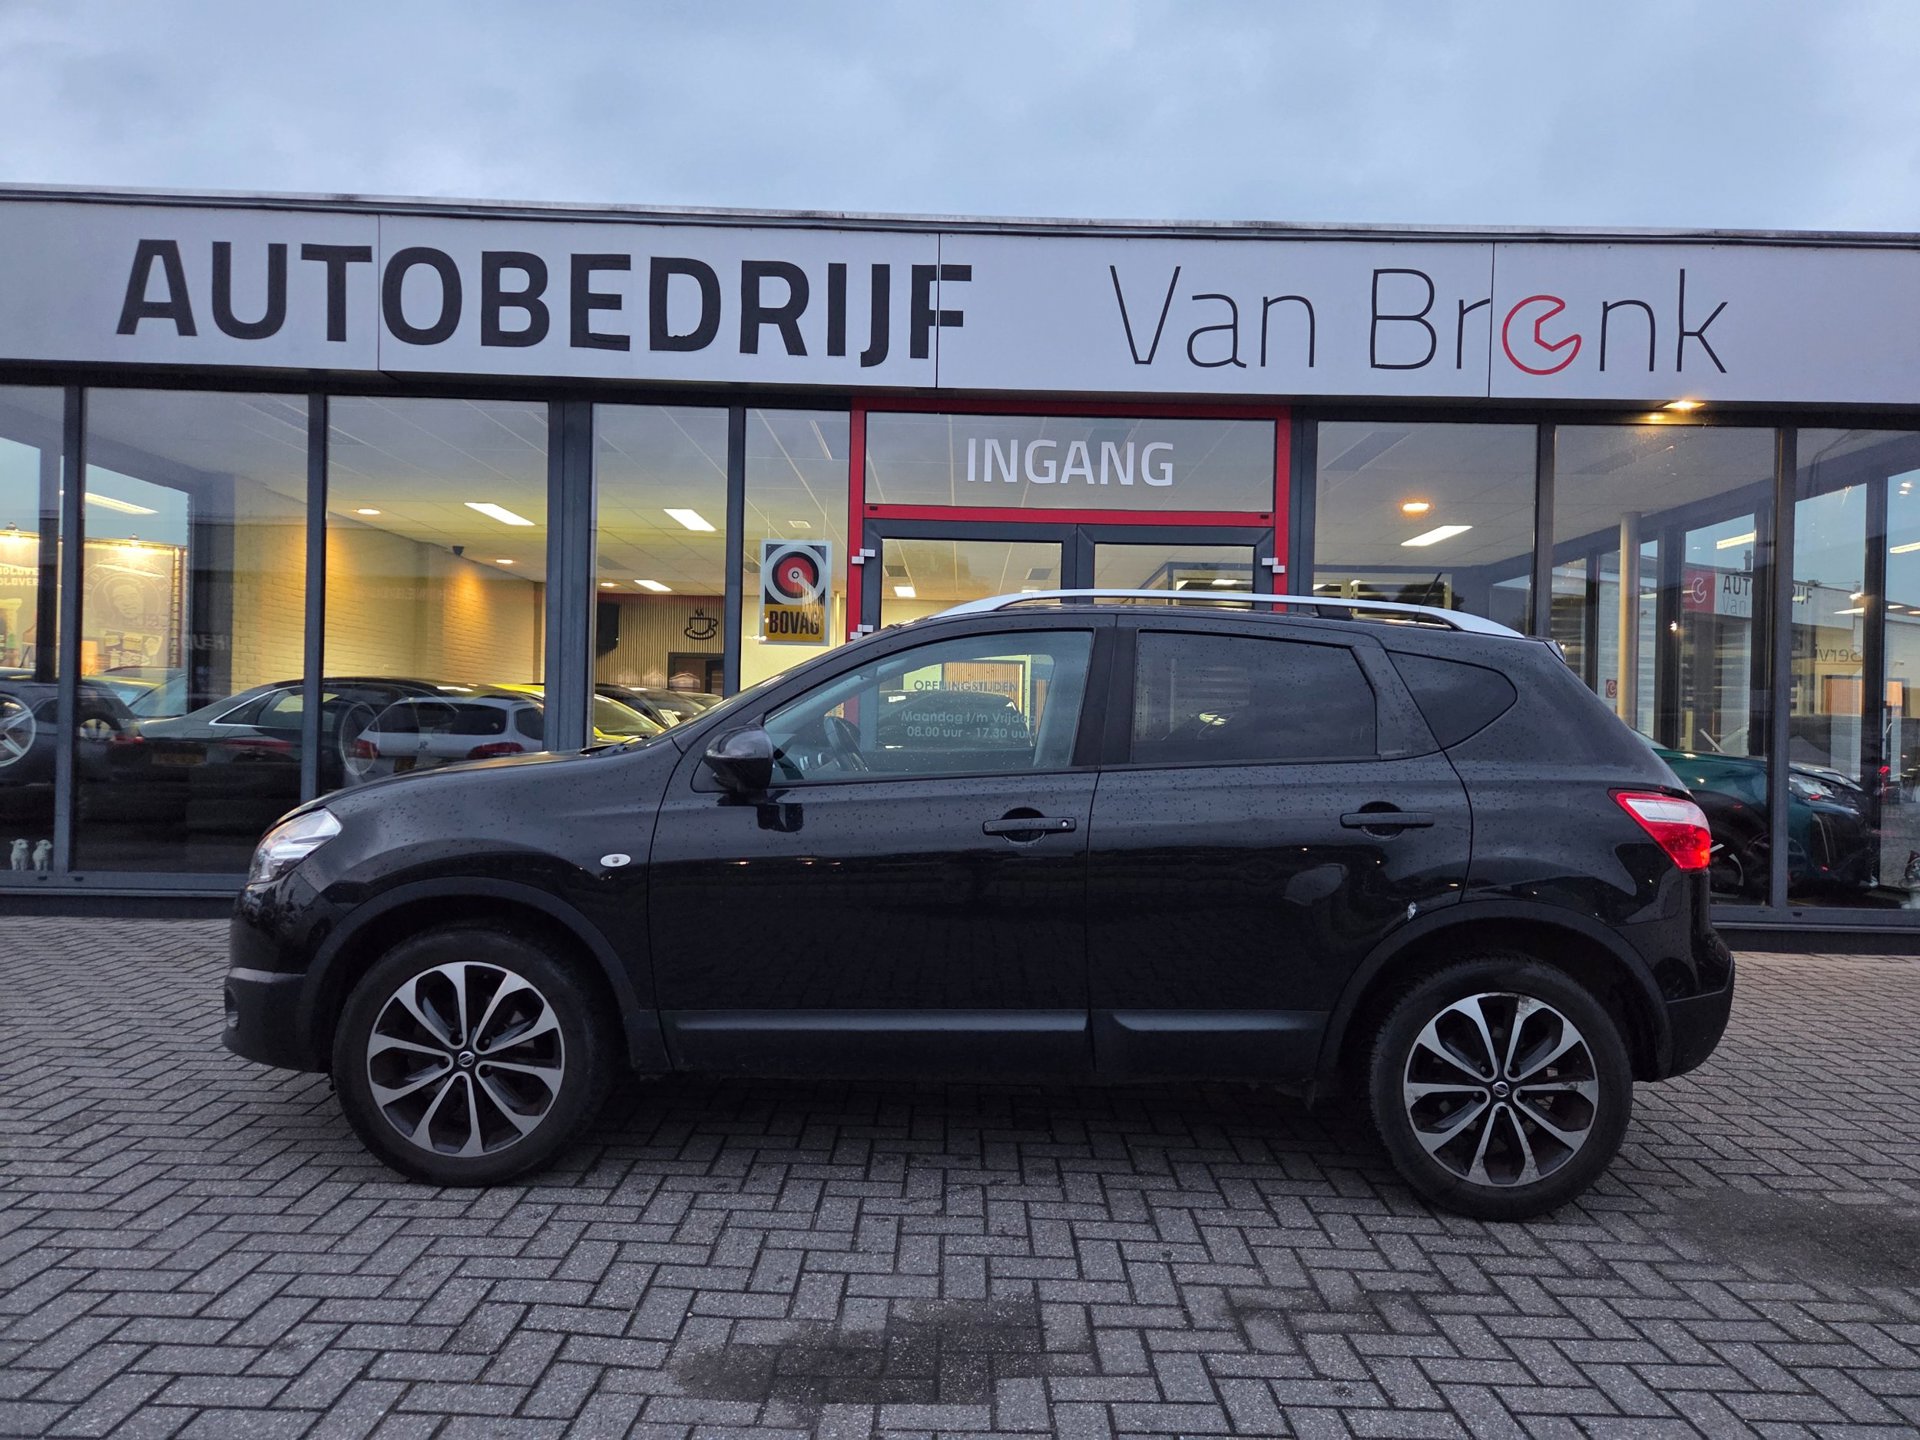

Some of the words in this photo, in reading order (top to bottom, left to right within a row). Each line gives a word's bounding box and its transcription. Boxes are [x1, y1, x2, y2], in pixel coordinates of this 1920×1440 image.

[117, 239, 973, 367] AUTOBEDRIJF
[1110, 265, 1314, 368] Van
[967, 438, 1174, 487] INGANG
[769, 610, 820, 635] BOVAG
[901, 711, 964, 724] Maandag
[907, 726, 940, 737] 08.00
